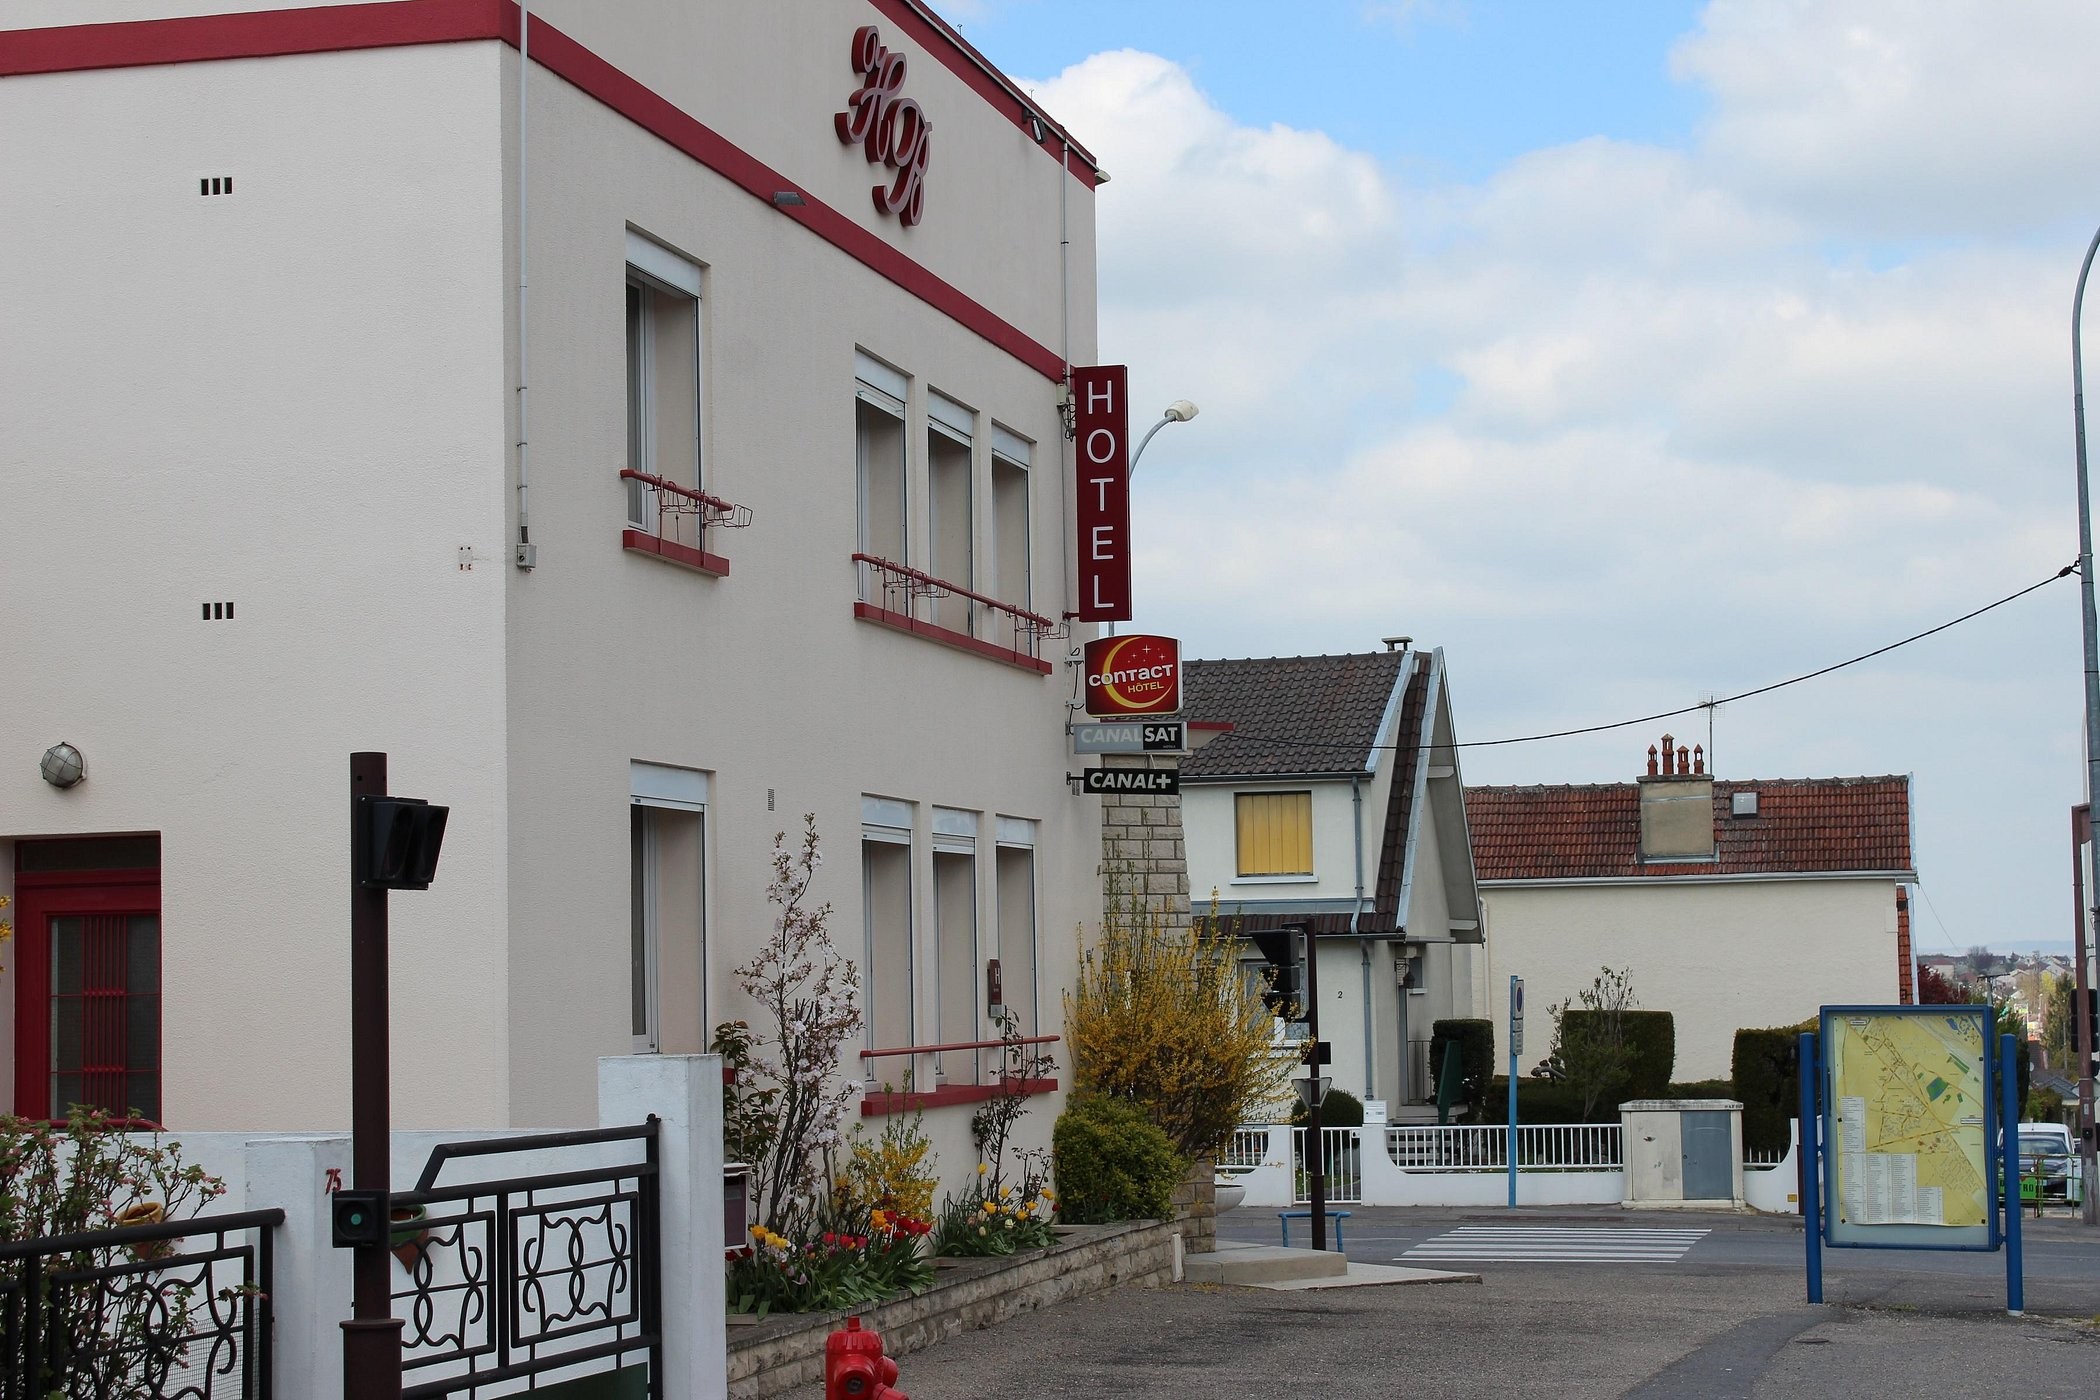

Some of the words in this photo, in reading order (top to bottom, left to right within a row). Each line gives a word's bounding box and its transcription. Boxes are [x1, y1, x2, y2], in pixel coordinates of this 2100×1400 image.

[1086, 379, 1116, 609] HOTEL
[1127, 681, 1164, 694] HÔTEL
[1089, 772, 1171, 789] CANAL+
[1337, 990, 1343, 999] 2
[325, 1168, 342, 1195] 75
